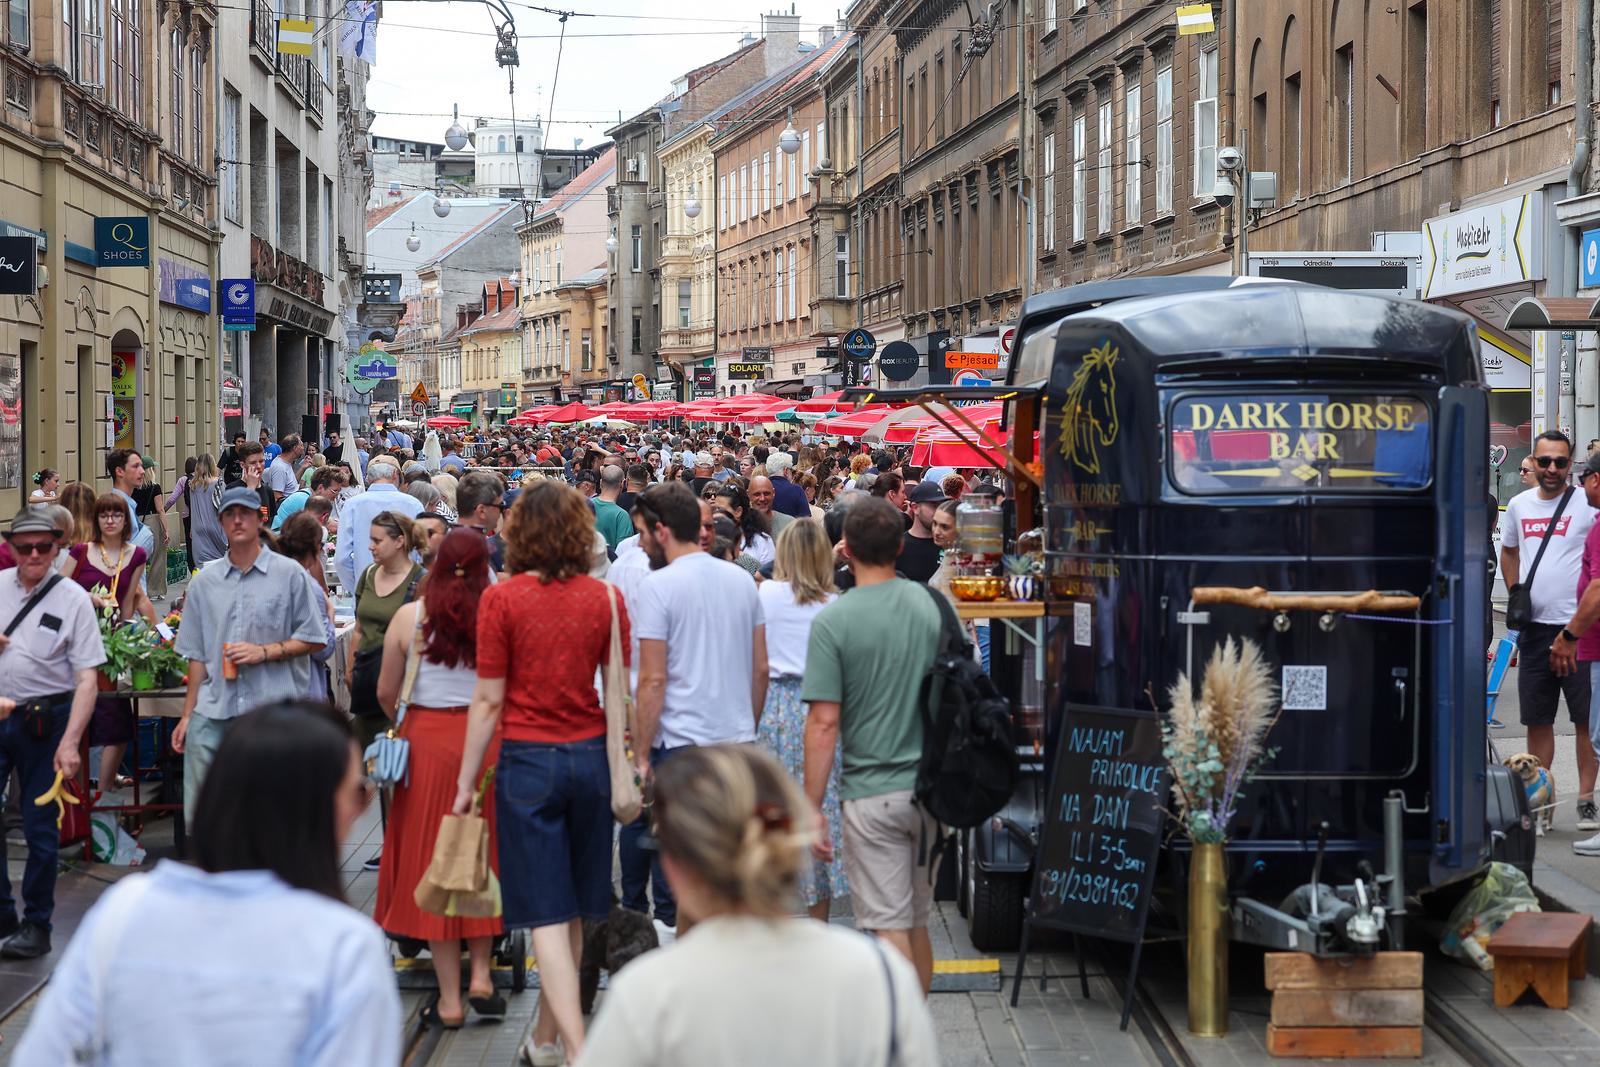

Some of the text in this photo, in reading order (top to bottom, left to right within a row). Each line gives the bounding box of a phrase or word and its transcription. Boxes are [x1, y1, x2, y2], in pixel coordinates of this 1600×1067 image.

[112, 223, 147, 251] Q
[103, 250, 142, 260] SHOES
[1303, 259, 1333, 267] Odredište
[730, 364, 765, 372] SOLARIJ
[960, 355, 996, 366] Pješaci
[414, 403, 423, 412] 40
[1190, 402, 1415, 431] DARK HORSE
[1270, 432, 1341, 460] BAR
[1068, 727, 1125, 757] NAJAM
[1089, 758, 1164, 796] PRIKOLICE
[1060, 792, 1130, 831] NA DAN
[1070, 831, 1095, 863] ILI
